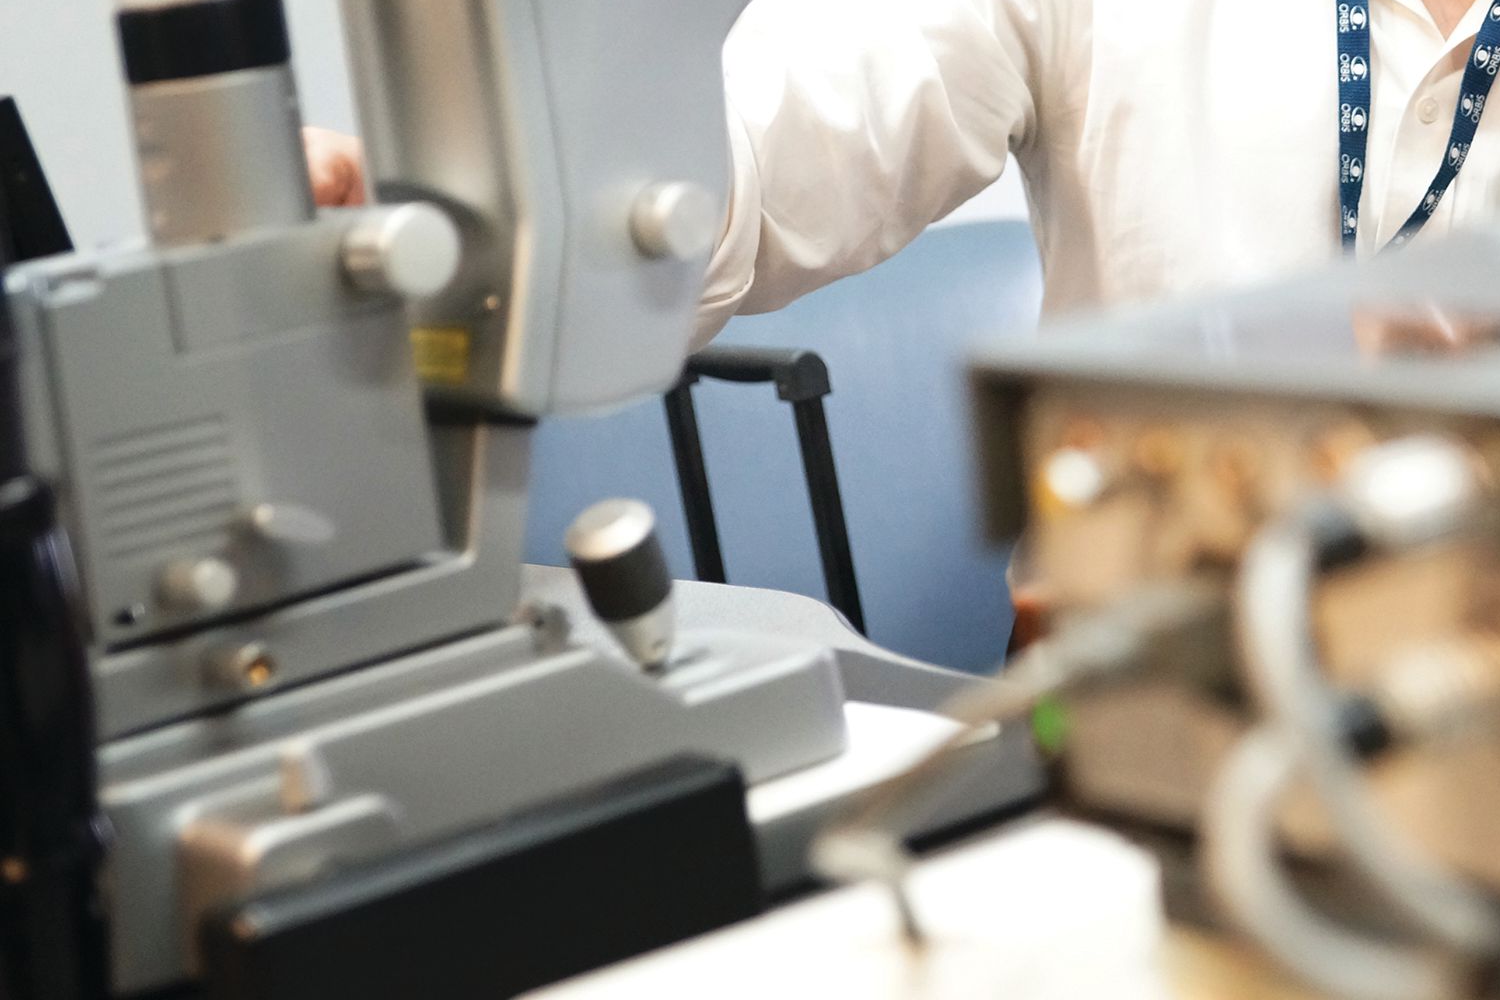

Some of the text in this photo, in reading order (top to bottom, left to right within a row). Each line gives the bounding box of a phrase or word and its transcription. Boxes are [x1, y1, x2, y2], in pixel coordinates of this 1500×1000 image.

[1339, 3, 1349, 33] ORBIS
[1340, 53, 1351, 82] ORBIS
[1341, 103, 1351, 132] ORBIS
[1471, 94, 1485, 123] ORBIS
